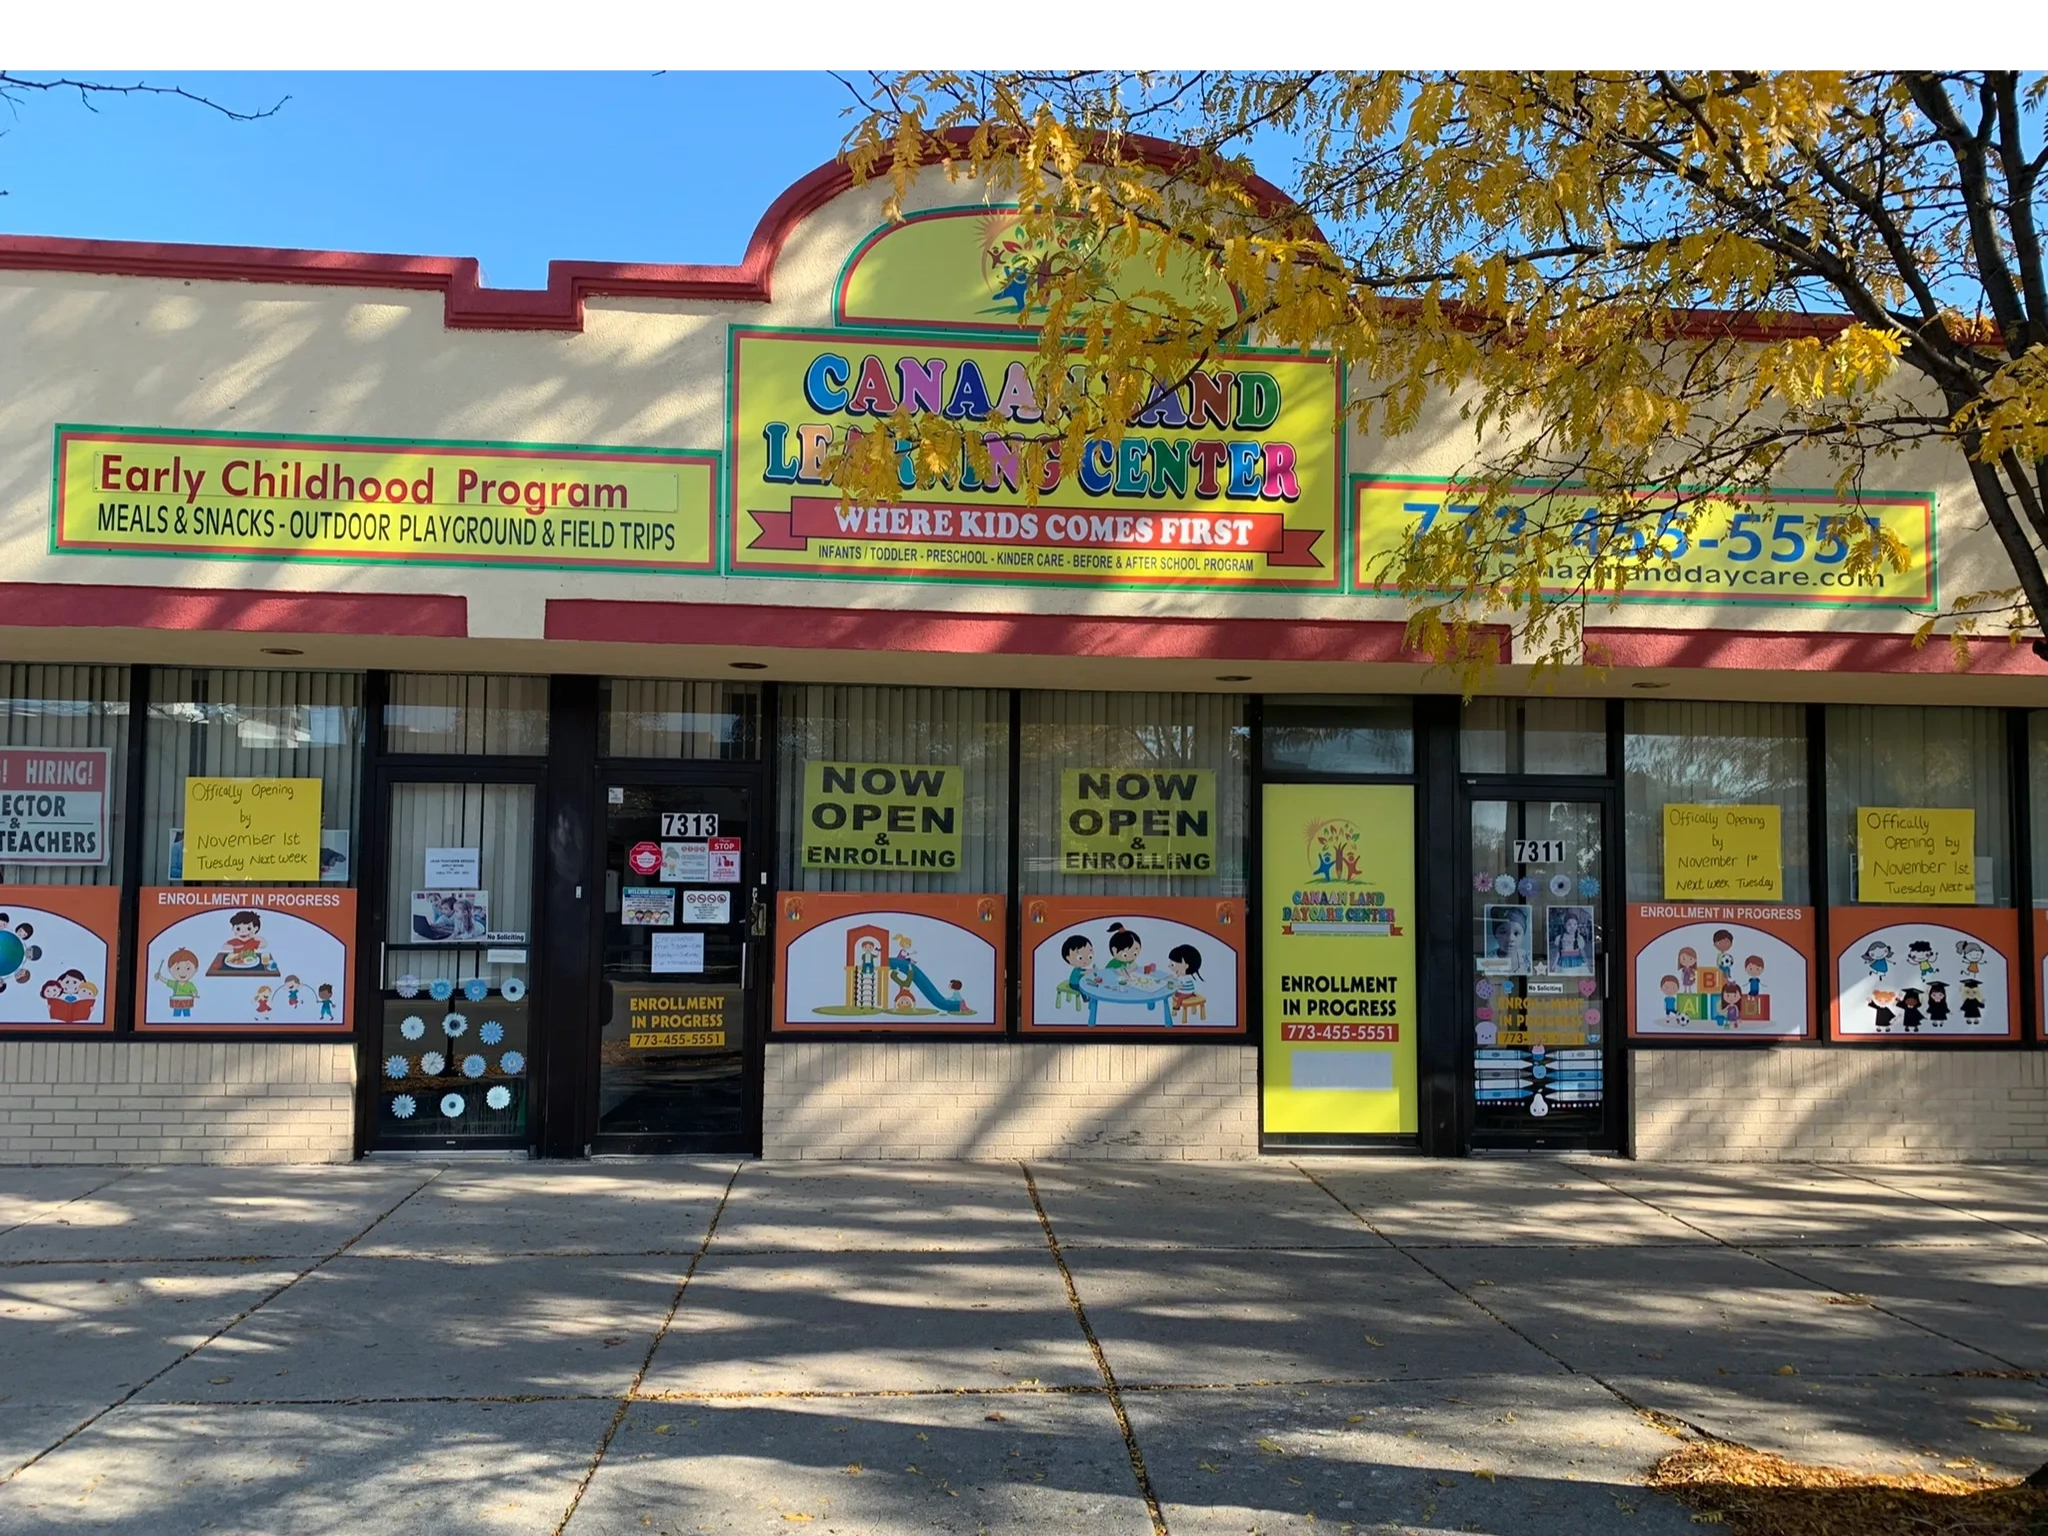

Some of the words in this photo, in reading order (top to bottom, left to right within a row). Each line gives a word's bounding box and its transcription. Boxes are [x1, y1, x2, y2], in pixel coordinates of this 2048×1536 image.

[1101, 366, 1281, 430] AND
[763, 421, 1064, 494] LEING
[1078, 436, 1301, 502] CENTER
[101, 454, 206, 504] Early
[221, 460, 434, 504] Childhood
[458, 469, 628, 515] Program
[98, 503, 168, 534] MEALS
[174, 506, 188, 535] &
[193, 506, 275, 537] SNACKS
[290, 510, 391, 540] OUTDOOR
[400, 514, 537, 546] PLAYGROUND
[542, 518, 555, 547] &
[561, 520, 615, 549] FIELD
[620, 522, 675, 551] TRIPS
[834, 505, 953, 536] WHERE
[960, 510, 1039, 540] KIDS
[1045, 514, 1154, 543] COMES
[1160, 517, 1253, 546] FIRST
[818, 544, 862, 560] INFANTS
[870, 547, 918, 562] TODDLER
[926, 548, 988, 564] PRESCHOOL
[997, 551, 1034, 566] KINDER
[1036, 553, 1064, 567] CARE
[1073, 554, 1113, 569] BEFORE
[1115, 556, 1123, 569] &
[1125, 556, 1157, 570] AFTER
[1160, 557, 1201, 571] SCHOOL
[1203, 557, 1254, 572] PROGRAM
[26, 759, 94, 786] HIRING!
[822, 766, 945, 797] NOW
[192, 782, 242, 804] Offically
[251, 783, 294, 800] Opening
[1078, 773, 1197, 801] NOW
[9, 817, 21, 829] &
[239, 808, 251, 829] by
[663, 814, 717, 836] 7313
[811, 802, 954, 834] OPEN
[1069, 808, 1208, 837] OPEN
[1669, 809, 1719, 830] Offically
[1726, 812, 1766, 830] Opening
[1866, 812, 1930, 835] Offically
[197, 834, 276, 850] November
[874, 832, 890, 846] &
[1130, 837, 1146, 850] &
[1712, 834, 1724, 851] by
[1884, 835, 1935, 855] Opening
[1945, 836, 1960, 855] by
[807, 846, 956, 867] ENROLLING
[1515, 841, 1564, 862] 7311
[197, 855, 244, 871] Tuesday
[250, 854, 275, 865] Next
[278, 853, 308, 864] week
[1066, 852, 1210, 870] ENROLLING
[1678, 856, 1738, 869] November
[1873, 860, 1947, 877] November
[1676, 879, 1705, 890] Next
[1707, 879, 1730, 889] week
[1735, 876, 1774, 890] Tuesday
[1884, 881, 1936, 897] Tuesday
[1939, 882, 1963, 893] Next
[158, 892, 248, 906] ENROLLMENT
[251, 893, 264, 906] IN
[267, 893, 340, 907] PROGRESS
[1292, 890, 1347, 906] CANAAN
[1349, 891, 1385, 906] LAND
[1282, 906, 1344, 922] DAYCARE
[1345, 907, 1395, 922] CENTER
[1640, 906, 1720, 918] ENROLLMENT
[1722, 907, 1735, 919] IN
[1738, 907, 1802, 920] PROGRESS
[497, 934, 525, 942] Soliciting
[1281, 975, 1398, 993] ENROLLMENT
[1537, 984, 1562, 992] Soliciting
[630, 996, 725, 1011] ENROLLMENT
[1283, 999, 1300, 1016] IN
[1307, 999, 1397, 1017] PROGRESS
[632, 1015, 646, 1028] IN
[651, 1014, 723, 1028] PROGRESS
[1499, 1014, 1512, 1027] IN
[636, 1034, 719, 1046] 773-455-5551
[1288, 1025, 1393, 1040] 773-455-5551
